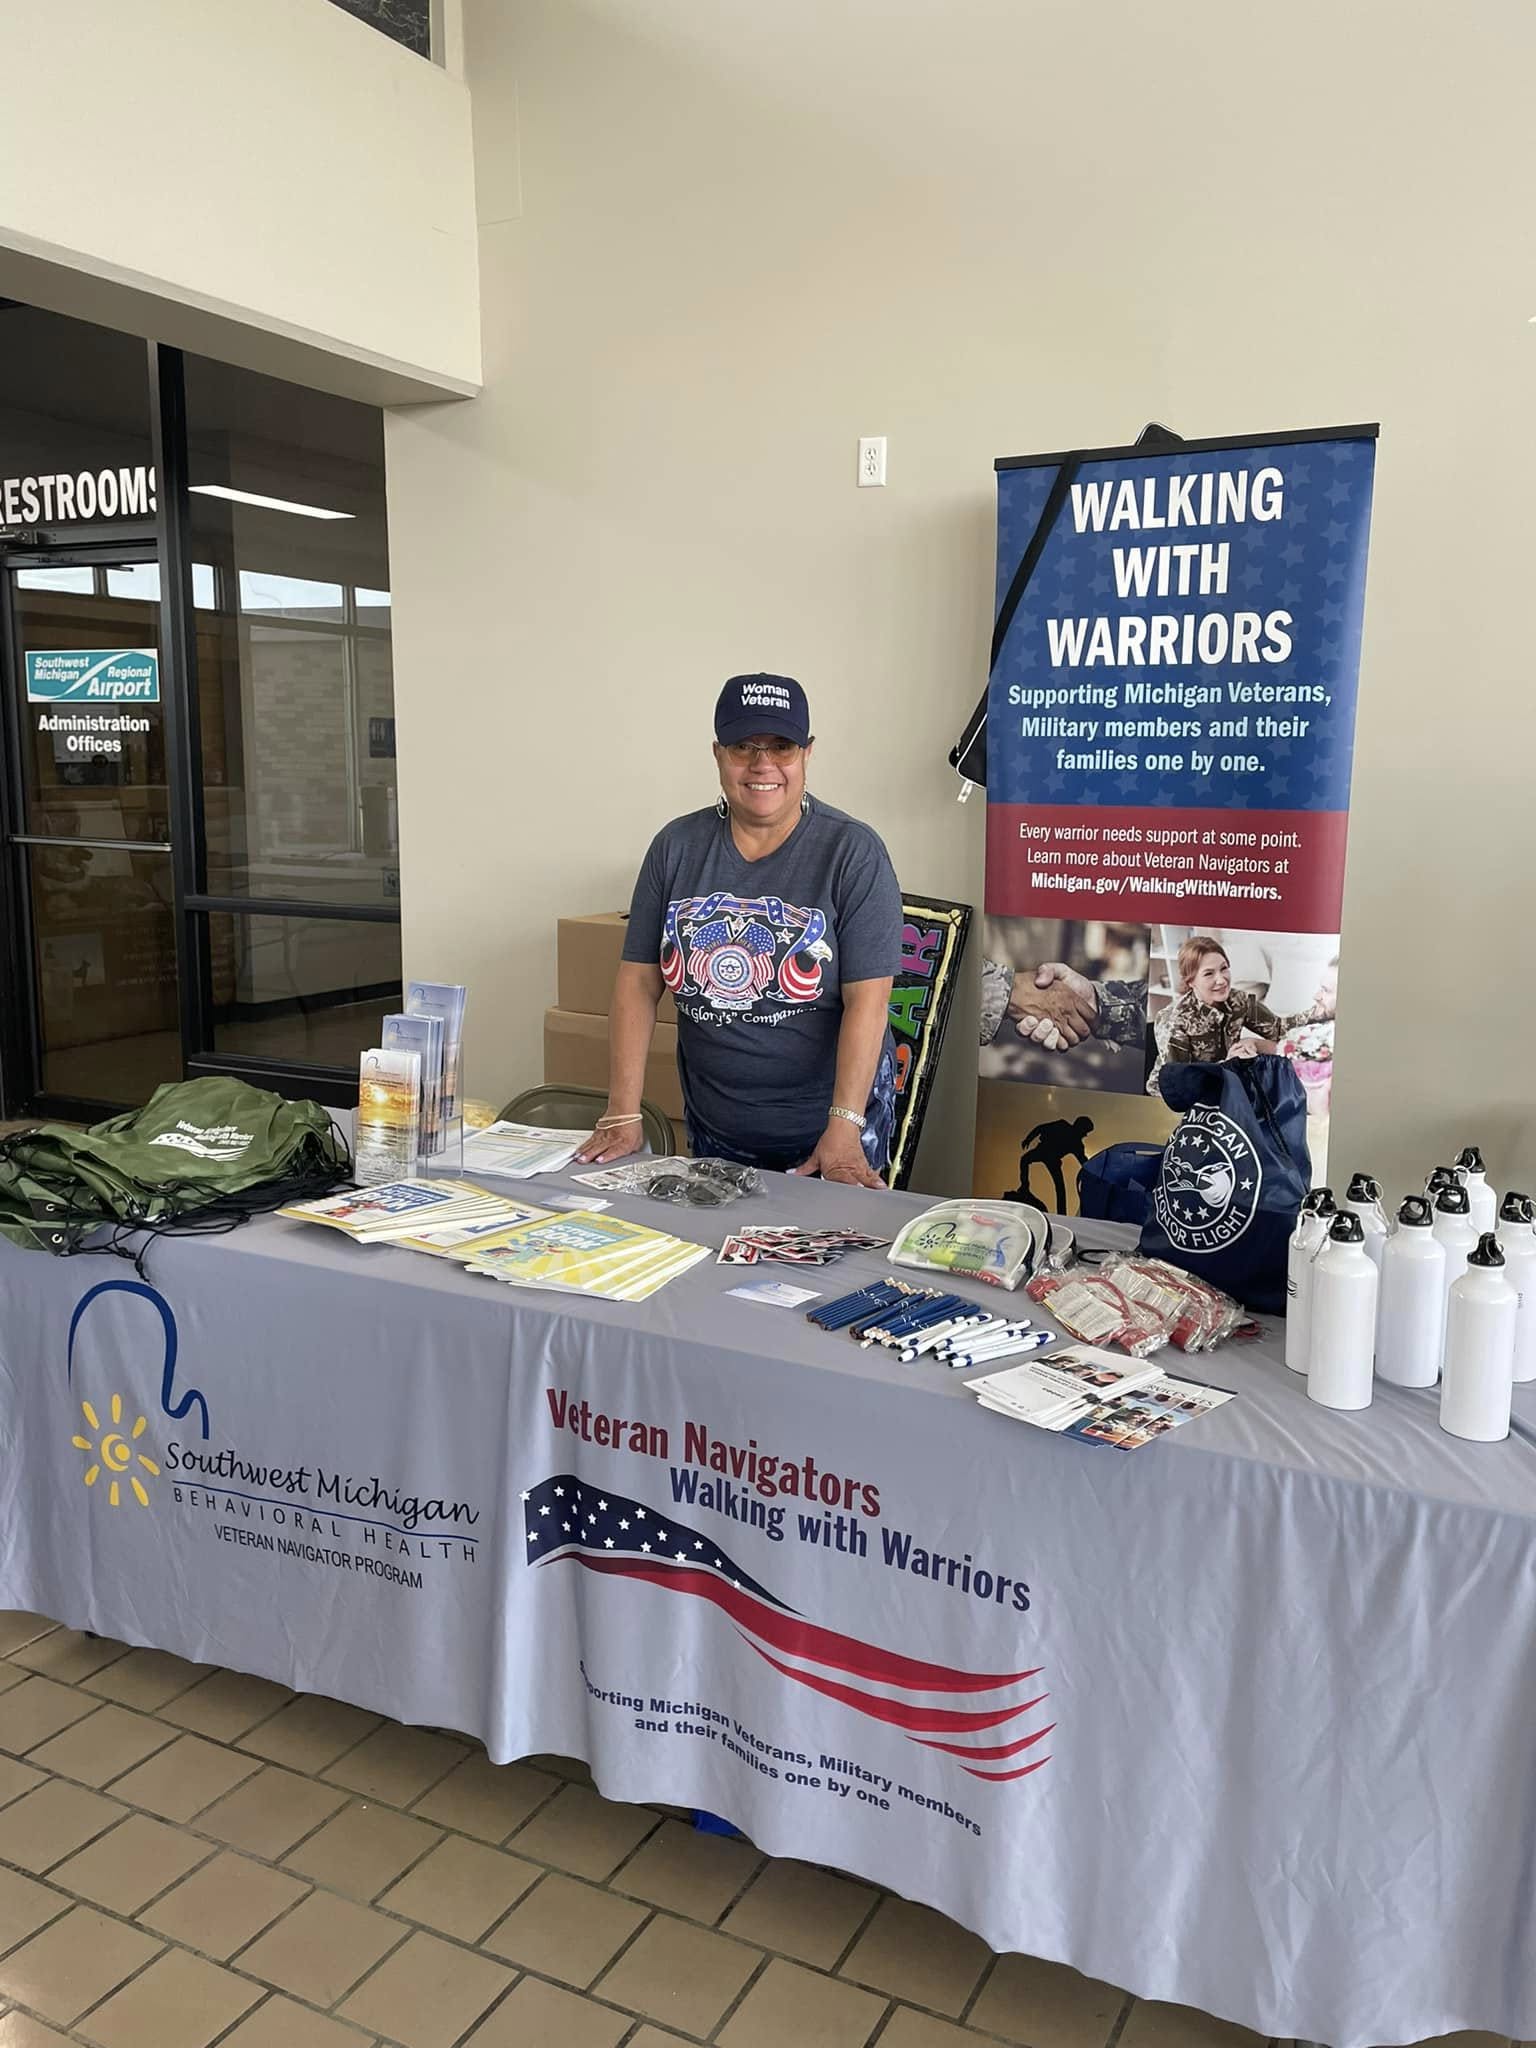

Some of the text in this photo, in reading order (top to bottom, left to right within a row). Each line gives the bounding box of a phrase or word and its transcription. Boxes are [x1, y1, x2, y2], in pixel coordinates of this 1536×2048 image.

[0, 466, 156, 524] ESTROOM
[1070, 467, 1284, 534] WALKING
[1112, 542, 1231, 598] WITH
[1046, 610, 1293, 667] WARRIORS
[34, 656, 89, 669] Southwest
[34, 668, 79, 682] Michigan
[107, 665, 152, 679] Regional
[87, 677, 151, 698] Airport
[742, 683, 790, 699] Woman
[1008, 682, 1332, 708] Supporting Michigan Veterans,
[741, 695, 790, 710] Veteran
[38, 714, 150, 732] Administration
[1021, 716, 1309, 741] Military members and their
[66, 736, 122, 752] Offices
[1056, 749, 1265, 775] families one by one.
[1019, 823, 1302, 850] Every warrior needs support at some point.
[1027, 847, 1289, 875] Learn more about Veteran Navigators at
[1031, 872, 1282, 901] Michigan.gov/WalkingWithWarriors.
[1152, 1186, 1247, 1247] HONOR FLIGHT
[525, 1227, 606, 1250] BOOK
[546, 1387, 881, 1518] Veteran Navigators
[165, 1442, 480, 1529] Southwest Michigan
[174, 1487, 476, 1563] BEHAVIORAL HEALTH
[670, 1467, 1032, 1612] Walking with Warriors
[214, 1523, 423, 1590] VETERAN NAVIGATOR PROGRAM
[634, 1717, 891, 1811] and their families one by one
[650, 1698, 730, 1728] Michigan
[732, 1720, 813, 1769] Veterans,
[819, 1754, 893, 1793] Military
[898, 1784, 982, 1837] members
